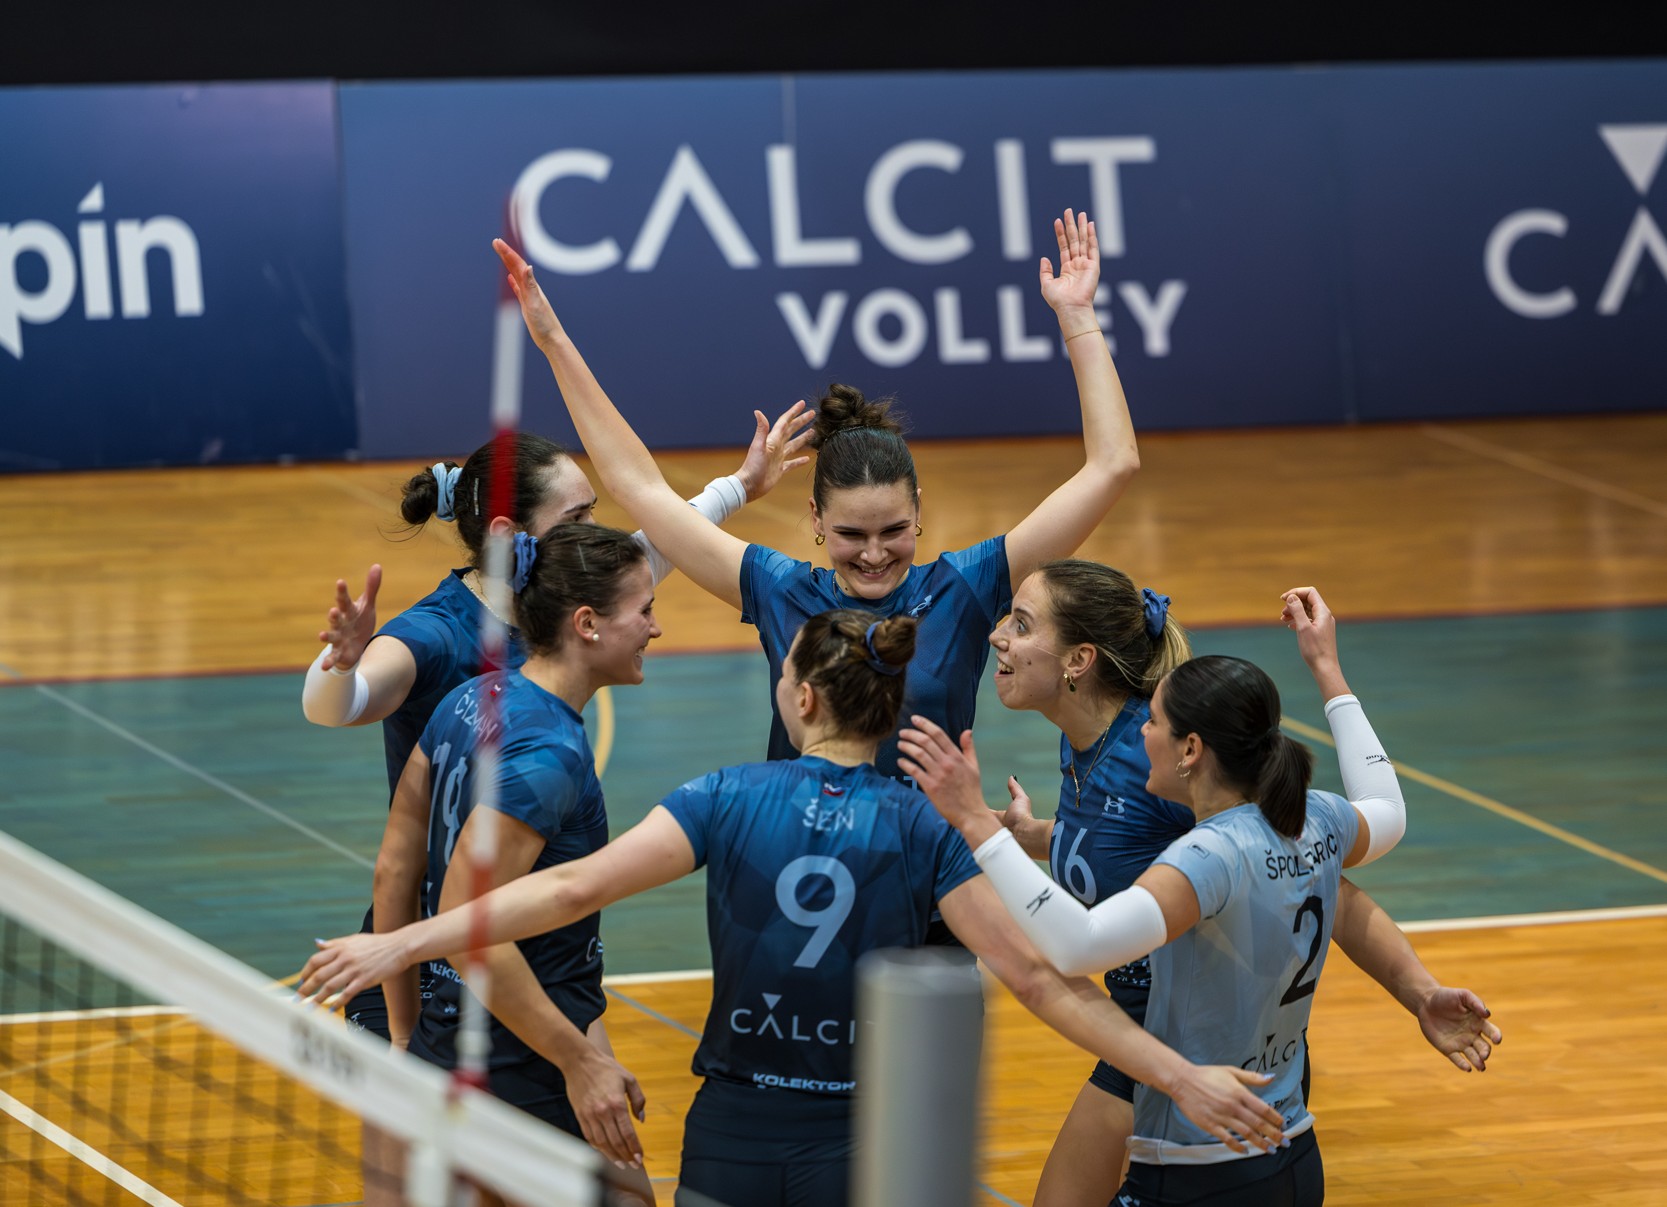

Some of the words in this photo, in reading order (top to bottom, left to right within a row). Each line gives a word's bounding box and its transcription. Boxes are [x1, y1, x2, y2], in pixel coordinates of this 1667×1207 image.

[510, 136, 1155, 275] CALCIT
[802, 797, 855, 831] ŠEN
[1051, 820, 1097, 905] 16
[775, 855, 856, 969] 9
[1279, 895, 1323, 1007] 2
[730, 1008, 856, 1046] CALCI
